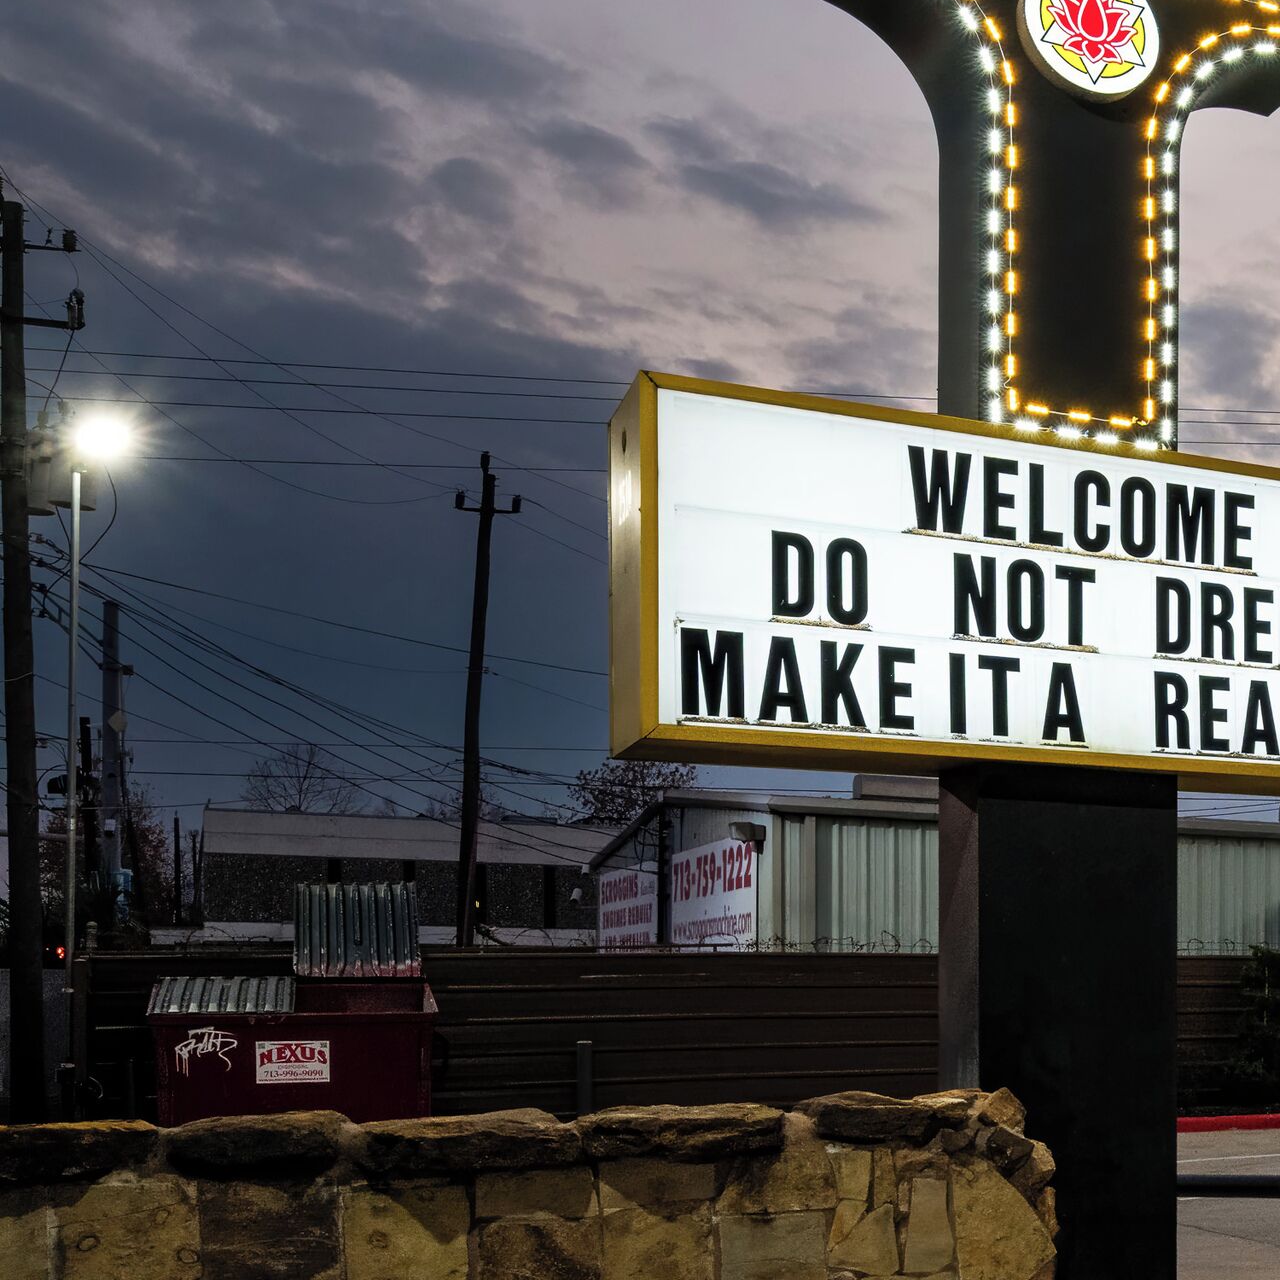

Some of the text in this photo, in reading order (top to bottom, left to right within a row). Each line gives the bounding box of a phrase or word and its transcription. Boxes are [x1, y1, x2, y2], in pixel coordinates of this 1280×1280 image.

[908, 446, 1255, 570] WELCOME
[771, 530, 868, 626] DO
[953, 553, 1096, 647] NOT
[680, 628, 915, 730] MAKE
[673, 841, 752, 903] 713-759-1222
[259, 1043, 328, 1067] NEXUS
[264, 1070, 323, 1078] 713-996-9090
